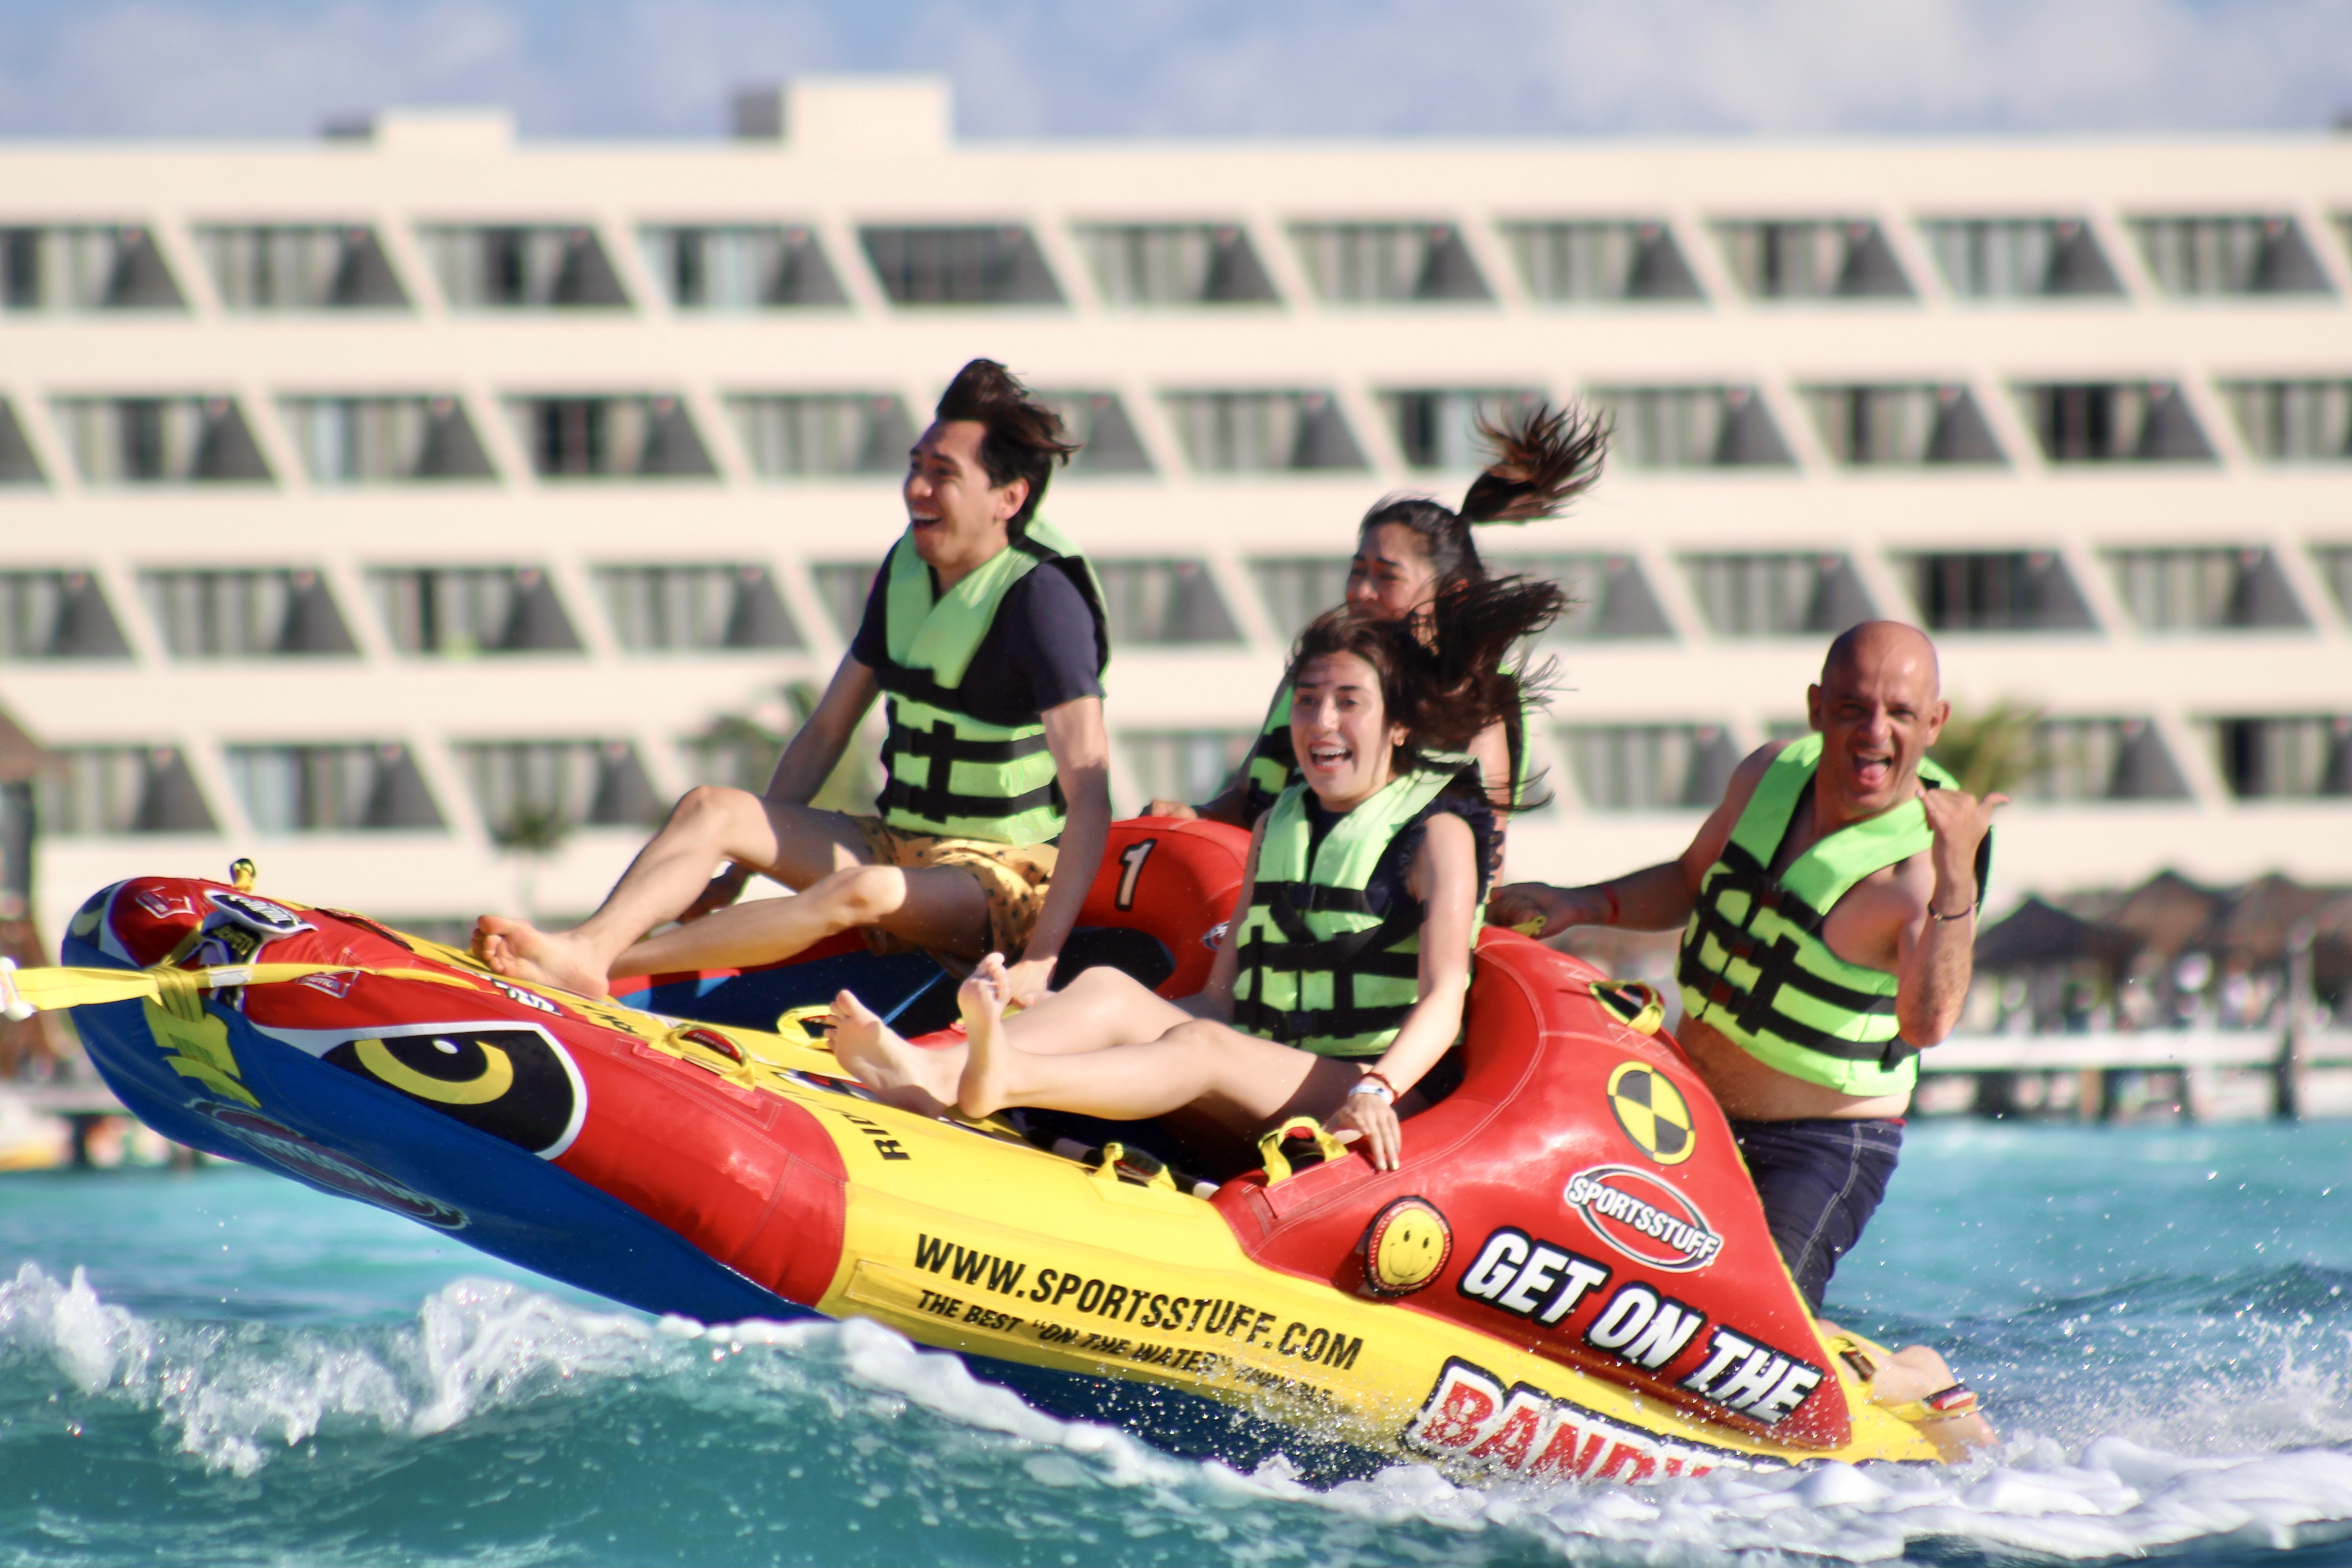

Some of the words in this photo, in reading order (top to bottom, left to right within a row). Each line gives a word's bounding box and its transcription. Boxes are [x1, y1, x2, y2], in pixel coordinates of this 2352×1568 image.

[1116, 839, 1157, 912] 1
[826, 1105, 911, 1161] RID
[1566, 1173, 1721, 1262] SPORTSSTUFF
[915, 1233, 1364, 1370] WWW.SPORTSSTUFF.COM
[918, 1289, 963, 1318] THE
[964, 1304, 1023, 1333] BEST
[1080, 1333, 1131, 1356] THE
[1462, 1232, 1606, 1324] GET
[1588, 1286, 1703, 1370] ON
[1681, 1329, 1823, 1424] THE
